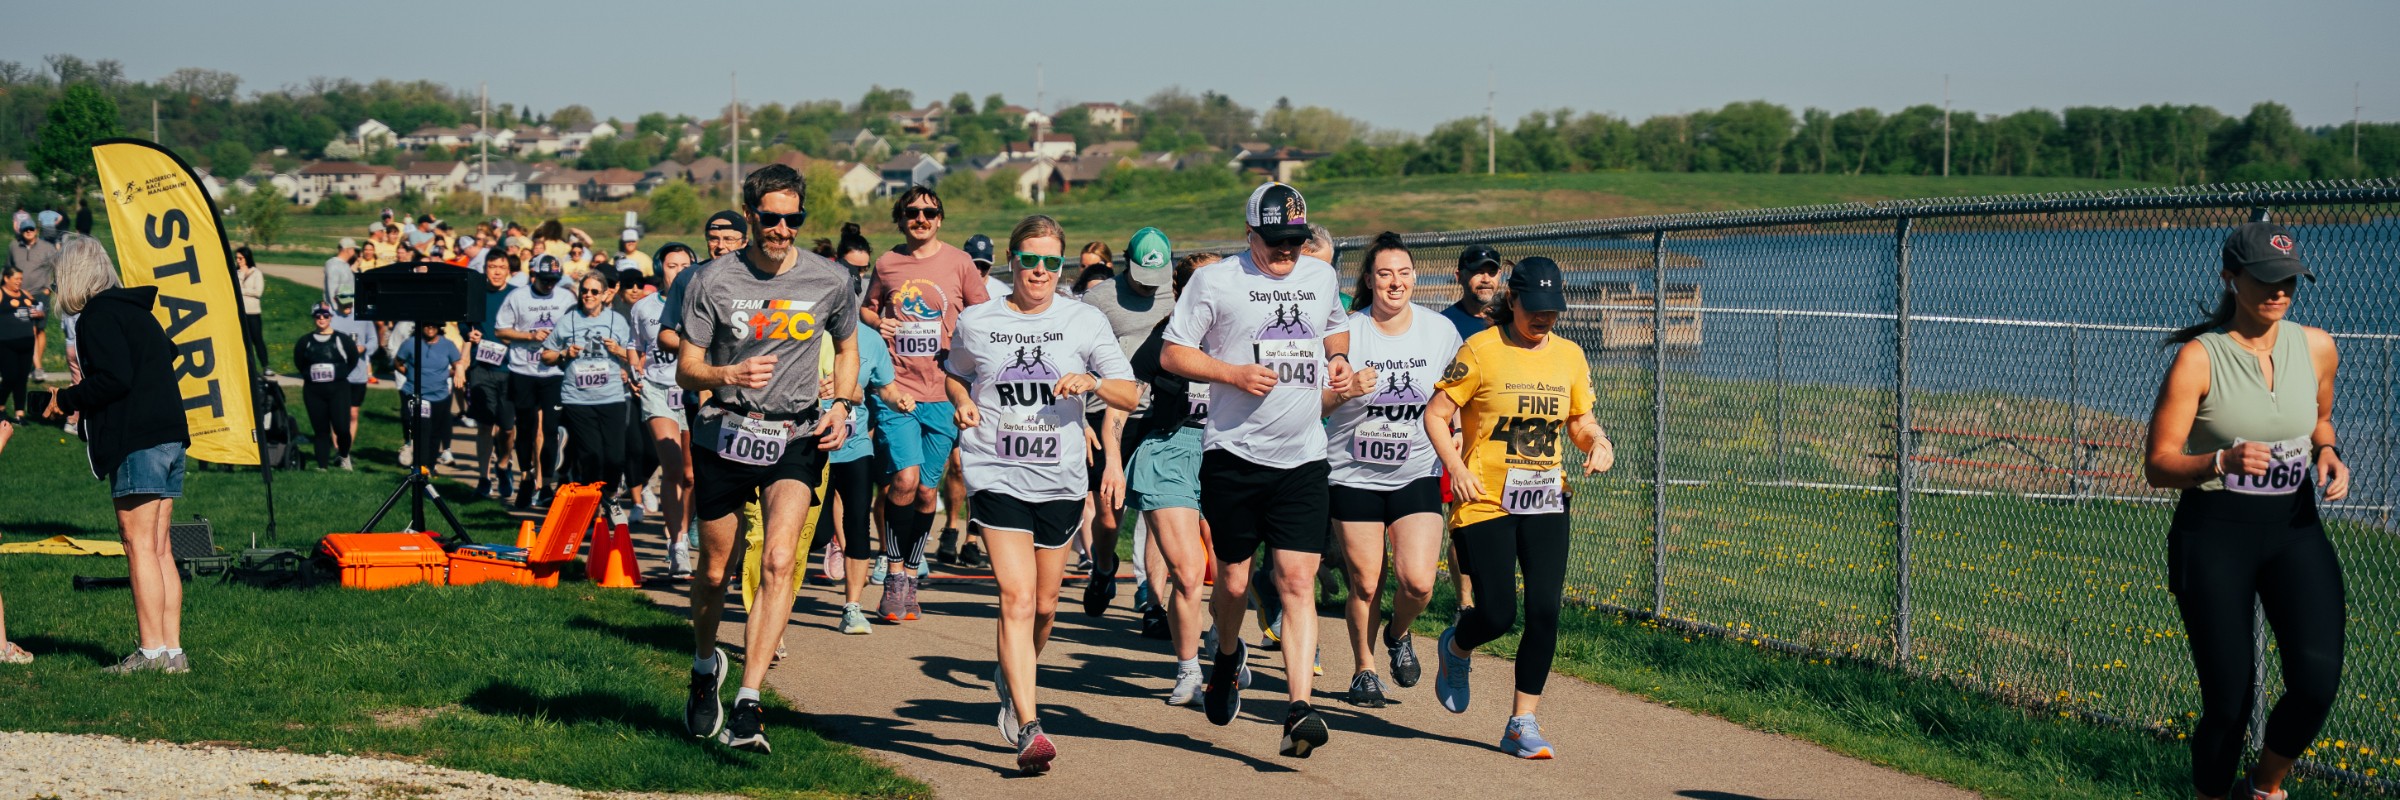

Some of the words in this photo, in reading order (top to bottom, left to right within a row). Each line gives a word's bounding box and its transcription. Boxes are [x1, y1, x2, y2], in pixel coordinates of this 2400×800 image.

[145, 173, 176, 184] ANDERSON
[1263, 216, 1281, 225] RUN
[1249, 290, 1271, 304] Stay
[1273, 290, 1292, 301] Out
[1297, 289, 1316, 301] Sun
[731, 299, 765, 309] TEAM
[144, 208, 224, 419] START
[898, 337, 938, 353] 1059
[990, 331, 1013, 345] Stay
[1015, 333, 1035, 344] Out
[1043, 331, 1063, 342] Sun
[480, 349, 501, 362] 1067
[1266, 350, 1276, 358] Stay
[1299, 350, 1314, 358] RUN
[1365, 359, 1384, 372] Stay
[1386, 359, 1403, 370] Out
[1410, 358, 1427, 368] Sun
[577, 374, 607, 386] 1025
[995, 382, 1057, 407] RUN
[1366, 404, 1427, 421] RUN
[1517, 395, 1559, 416] FINE
[762, 428, 780, 437] RUN
[1003, 422, 1014, 432] Stay
[1039, 424, 1056, 432] RUN
[724, 433, 780, 463] 1069
[1002, 435, 1057, 458] 1042
[1358, 440, 1408, 461] 1052
[2285, 448, 2303, 460] RUN
[1512, 478, 1523, 486] Stay
[1509, 488, 1559, 510] 1004
